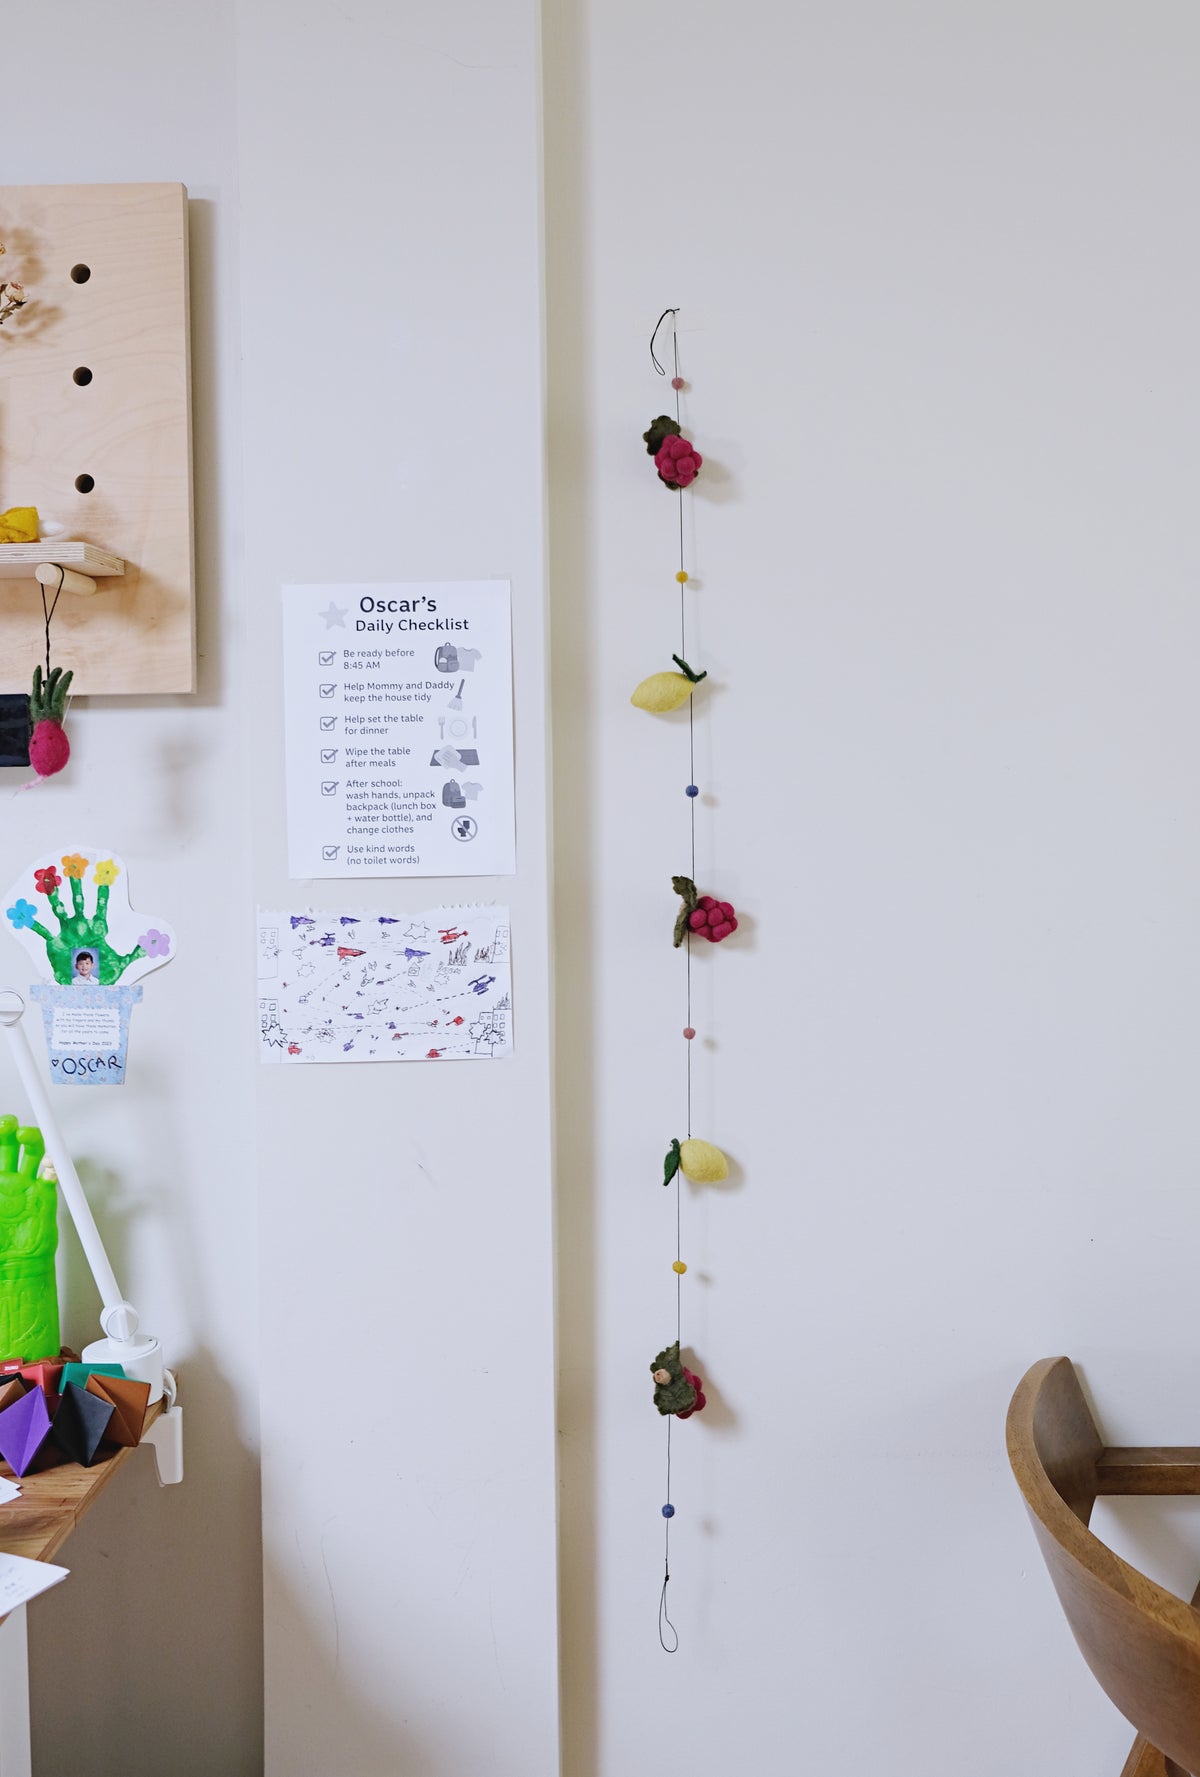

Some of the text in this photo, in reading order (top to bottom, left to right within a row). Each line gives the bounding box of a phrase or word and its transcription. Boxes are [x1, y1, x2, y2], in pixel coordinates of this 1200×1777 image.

[359, 596, 438, 613] Oscar's
[356, 617, 470, 635] Daily Checklist
[343, 648, 415, 659] Be ready before
[343, 661, 381, 670] 8:45 AM
[344, 681, 455, 692] Help Mommy and Daddy
[344, 692, 432, 703] keep the house tidy
[344, 714, 424, 725] Help set the table
[344, 726, 389, 735] for dinner
[345, 746, 411, 757] Wipe the table
[345, 758, 396, 768] after meals
[346, 779, 403, 788] After school:
[346, 790, 436, 800] wash hands, unpack
[346, 801, 437, 812] backpack (lunch box
[354, 815, 380, 823] water
[382, 813, 414, 823] bottle),
[415, 813, 433, 822] and
[346, 825, 414, 836] change clothes
[347, 844, 415, 853] Use kind words
[347, 855, 420, 866] (no toilet words)
[61, 1055, 123, 1076] OSCAR
